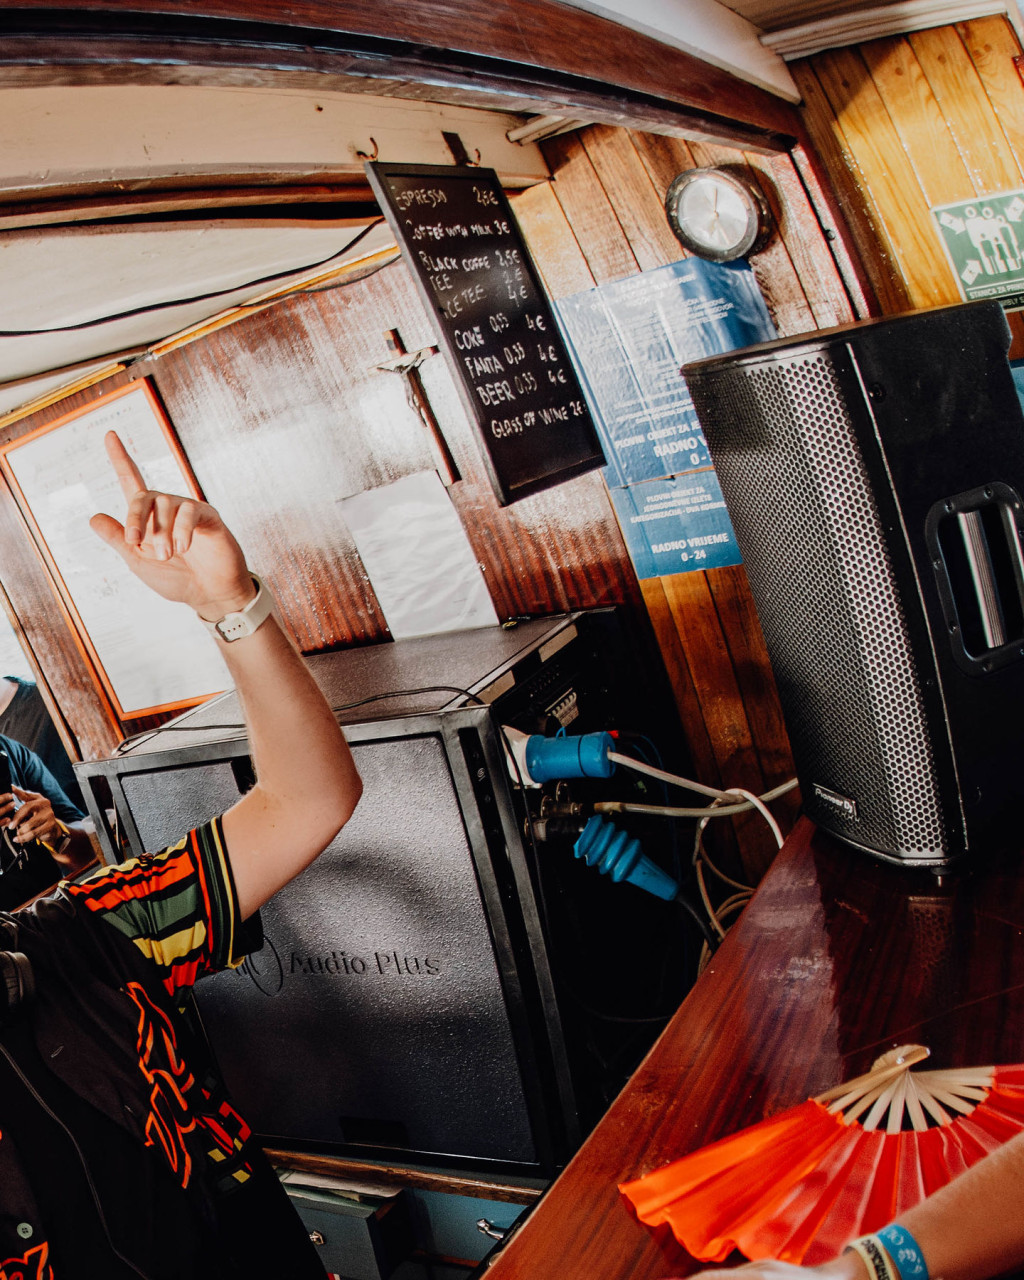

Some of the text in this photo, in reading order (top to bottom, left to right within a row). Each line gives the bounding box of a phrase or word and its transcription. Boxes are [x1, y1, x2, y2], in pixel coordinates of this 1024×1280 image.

[418, 251, 459, 272] BLACK
[429, 273, 453, 291] TEE
[461, 283, 487, 303] TEE
[454, 326, 484, 350] COKE
[464, 354, 505, 379] FANTA
[476, 380, 516, 406] BEER
[538, 405, 569, 425] WINE
[653, 437, 698, 457] RADNO
[651, 533, 729, 554] RADNO VRIJEME
[290, 951, 440, 975] Audio Plus
